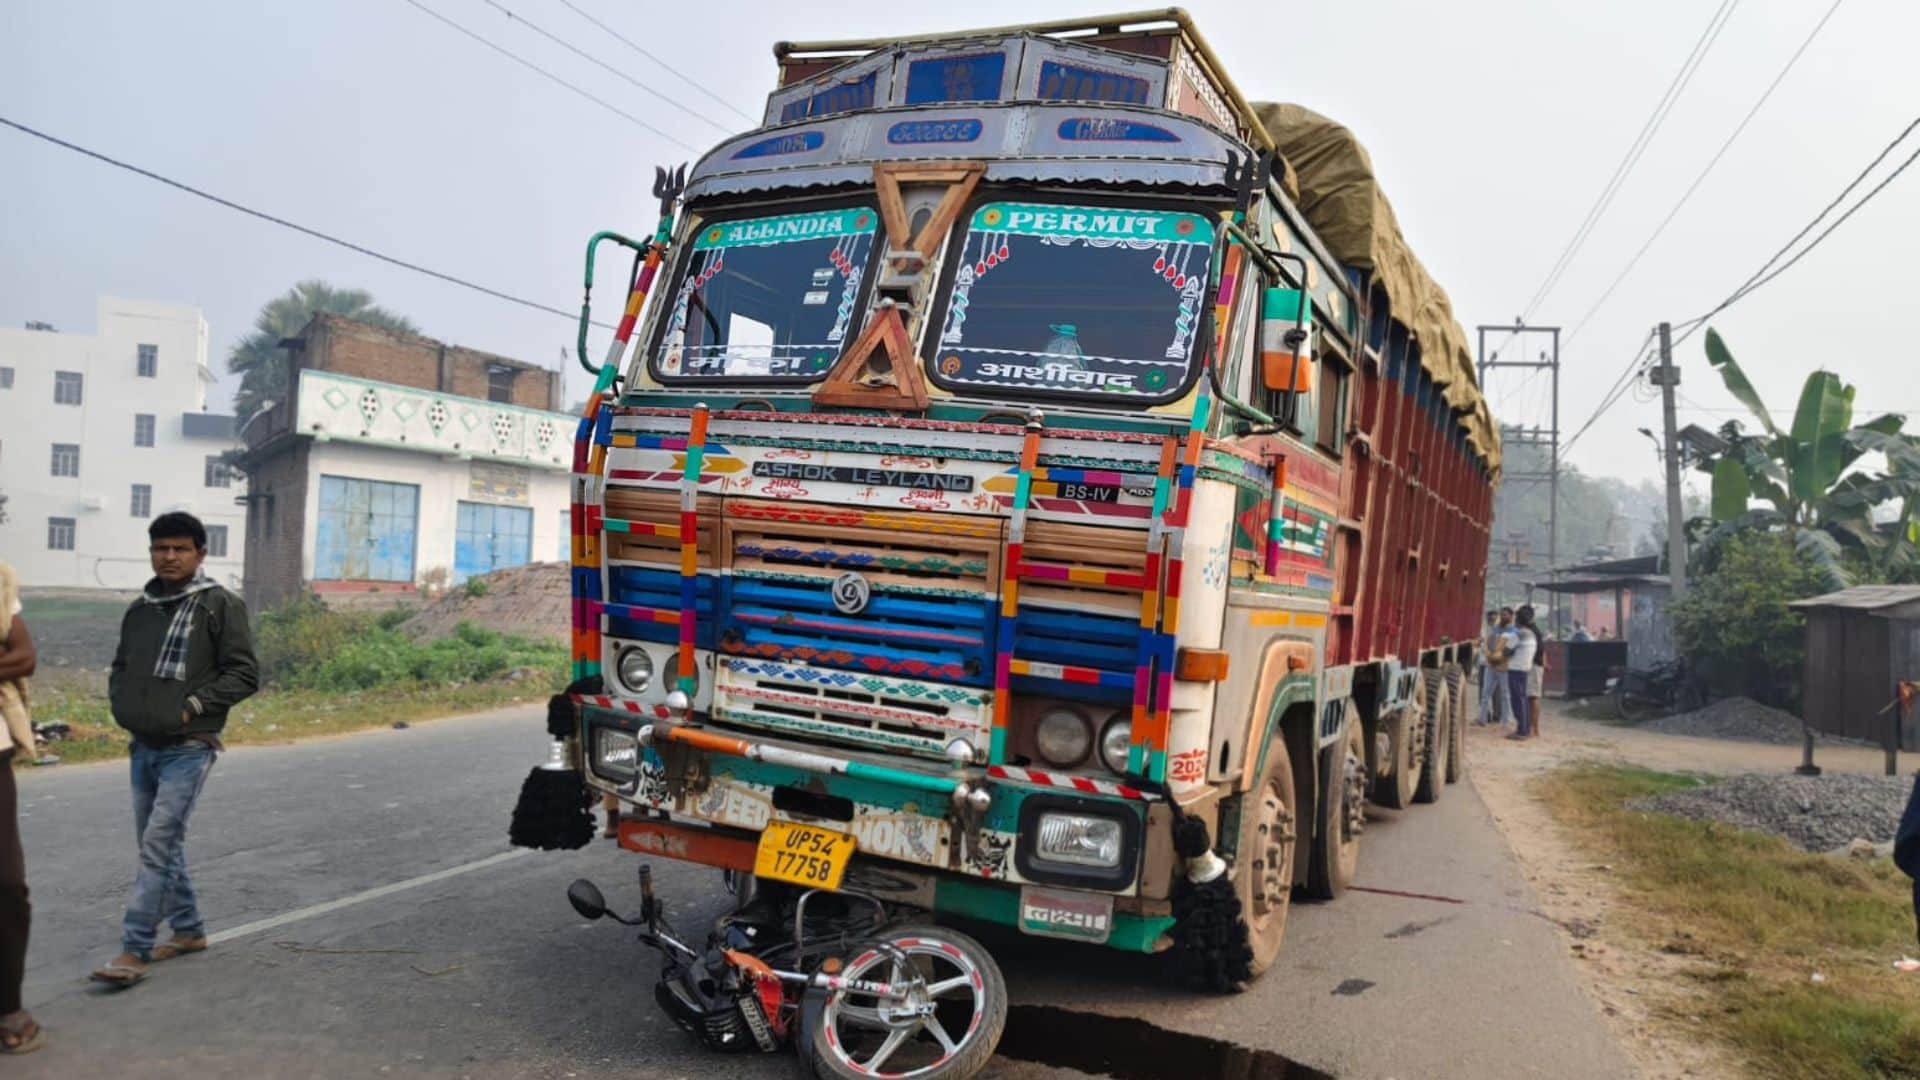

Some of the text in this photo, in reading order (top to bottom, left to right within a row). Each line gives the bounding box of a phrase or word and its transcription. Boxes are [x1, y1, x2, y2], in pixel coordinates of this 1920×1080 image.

[1007, 211, 1163, 235] PERMIT
[755, 462, 970, 490] ASHOK LEYLAND
[1064, 484, 1111, 502] BS-IV
[785, 829, 837, 856] UP54
[773, 850, 832, 882] T7758
